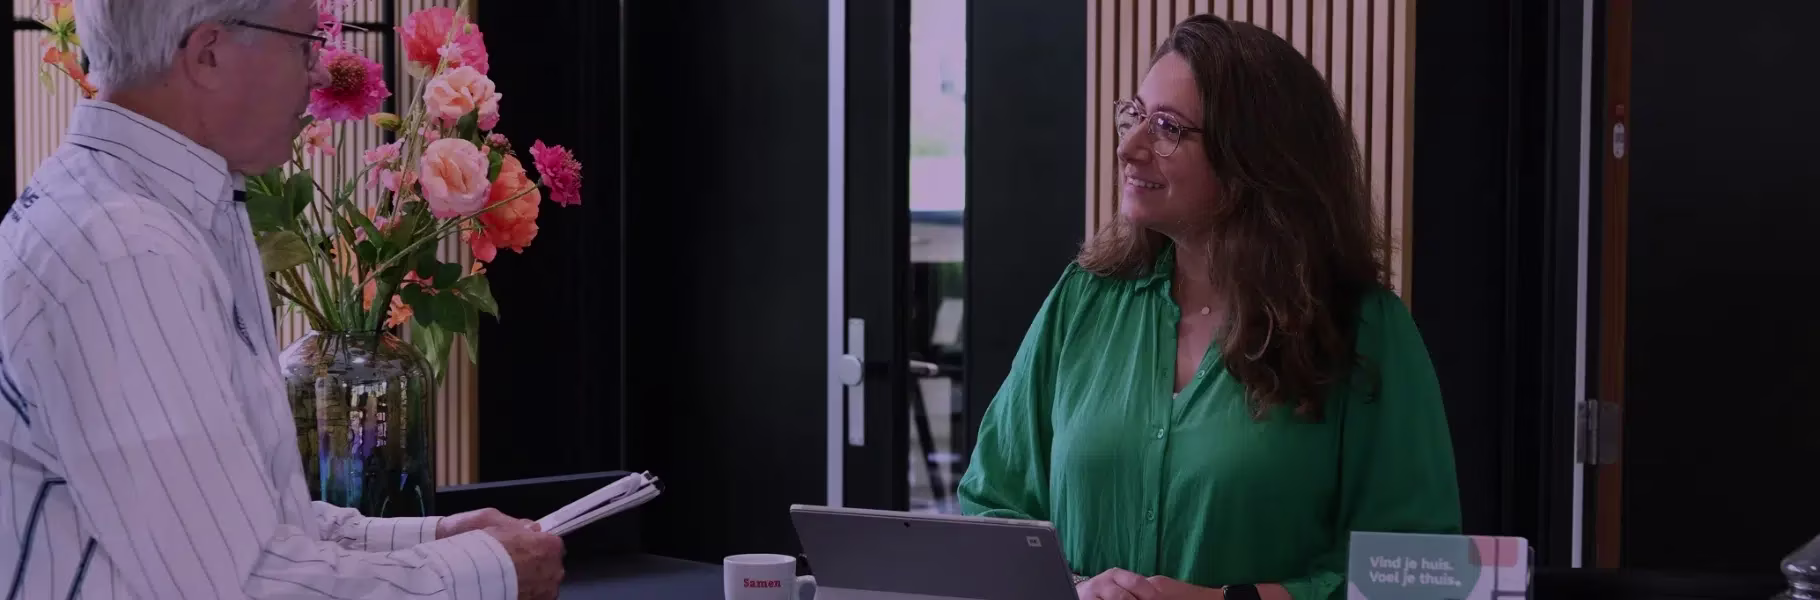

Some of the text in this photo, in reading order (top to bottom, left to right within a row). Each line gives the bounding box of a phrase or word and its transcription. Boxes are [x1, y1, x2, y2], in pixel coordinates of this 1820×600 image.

[1369, 556, 1454, 571] Vind je huis.
[743, 578, 781, 588] Samen
[1369, 572, 1461, 587] Voel je thuis.
